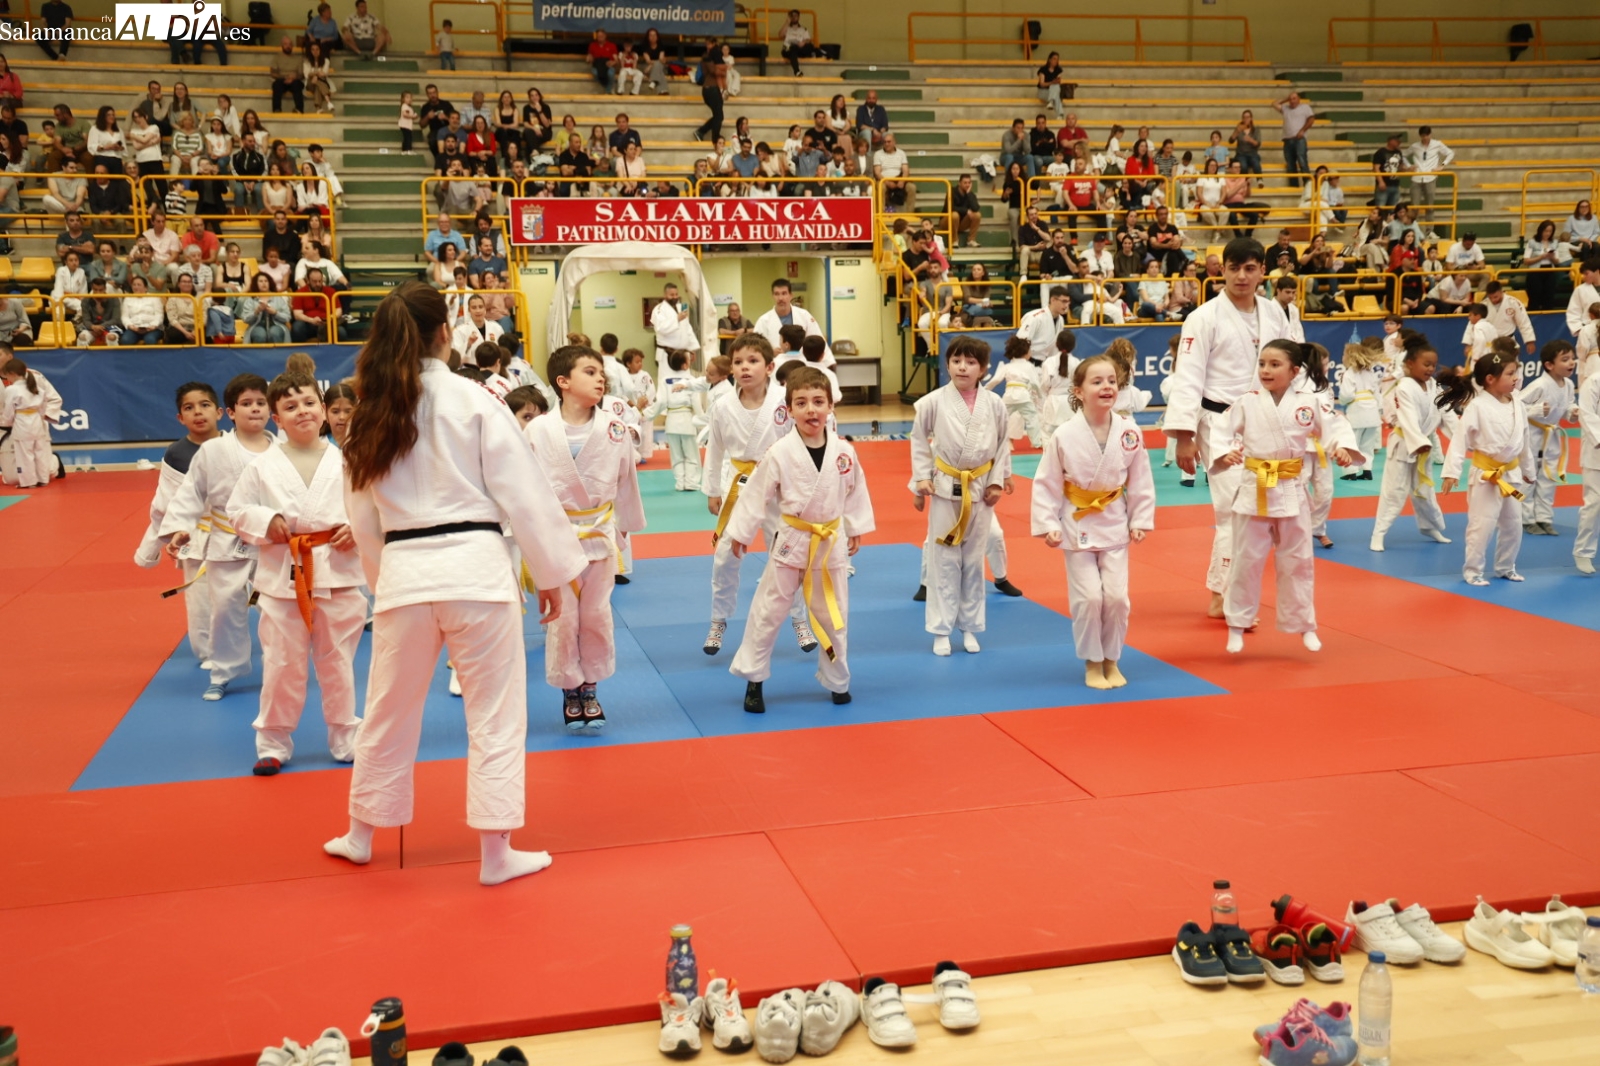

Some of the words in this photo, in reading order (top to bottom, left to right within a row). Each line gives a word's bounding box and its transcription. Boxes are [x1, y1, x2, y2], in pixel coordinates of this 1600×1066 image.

[541, 3, 725, 22] perfumeriasavenida.com
[595, 201, 832, 223] SALAMANCA
[557, 225, 681, 242] PATRIMONIO
[686, 225, 713, 241] DE
[719, 224, 743, 240] LA
[749, 223, 863, 240] HUMANIDAD
